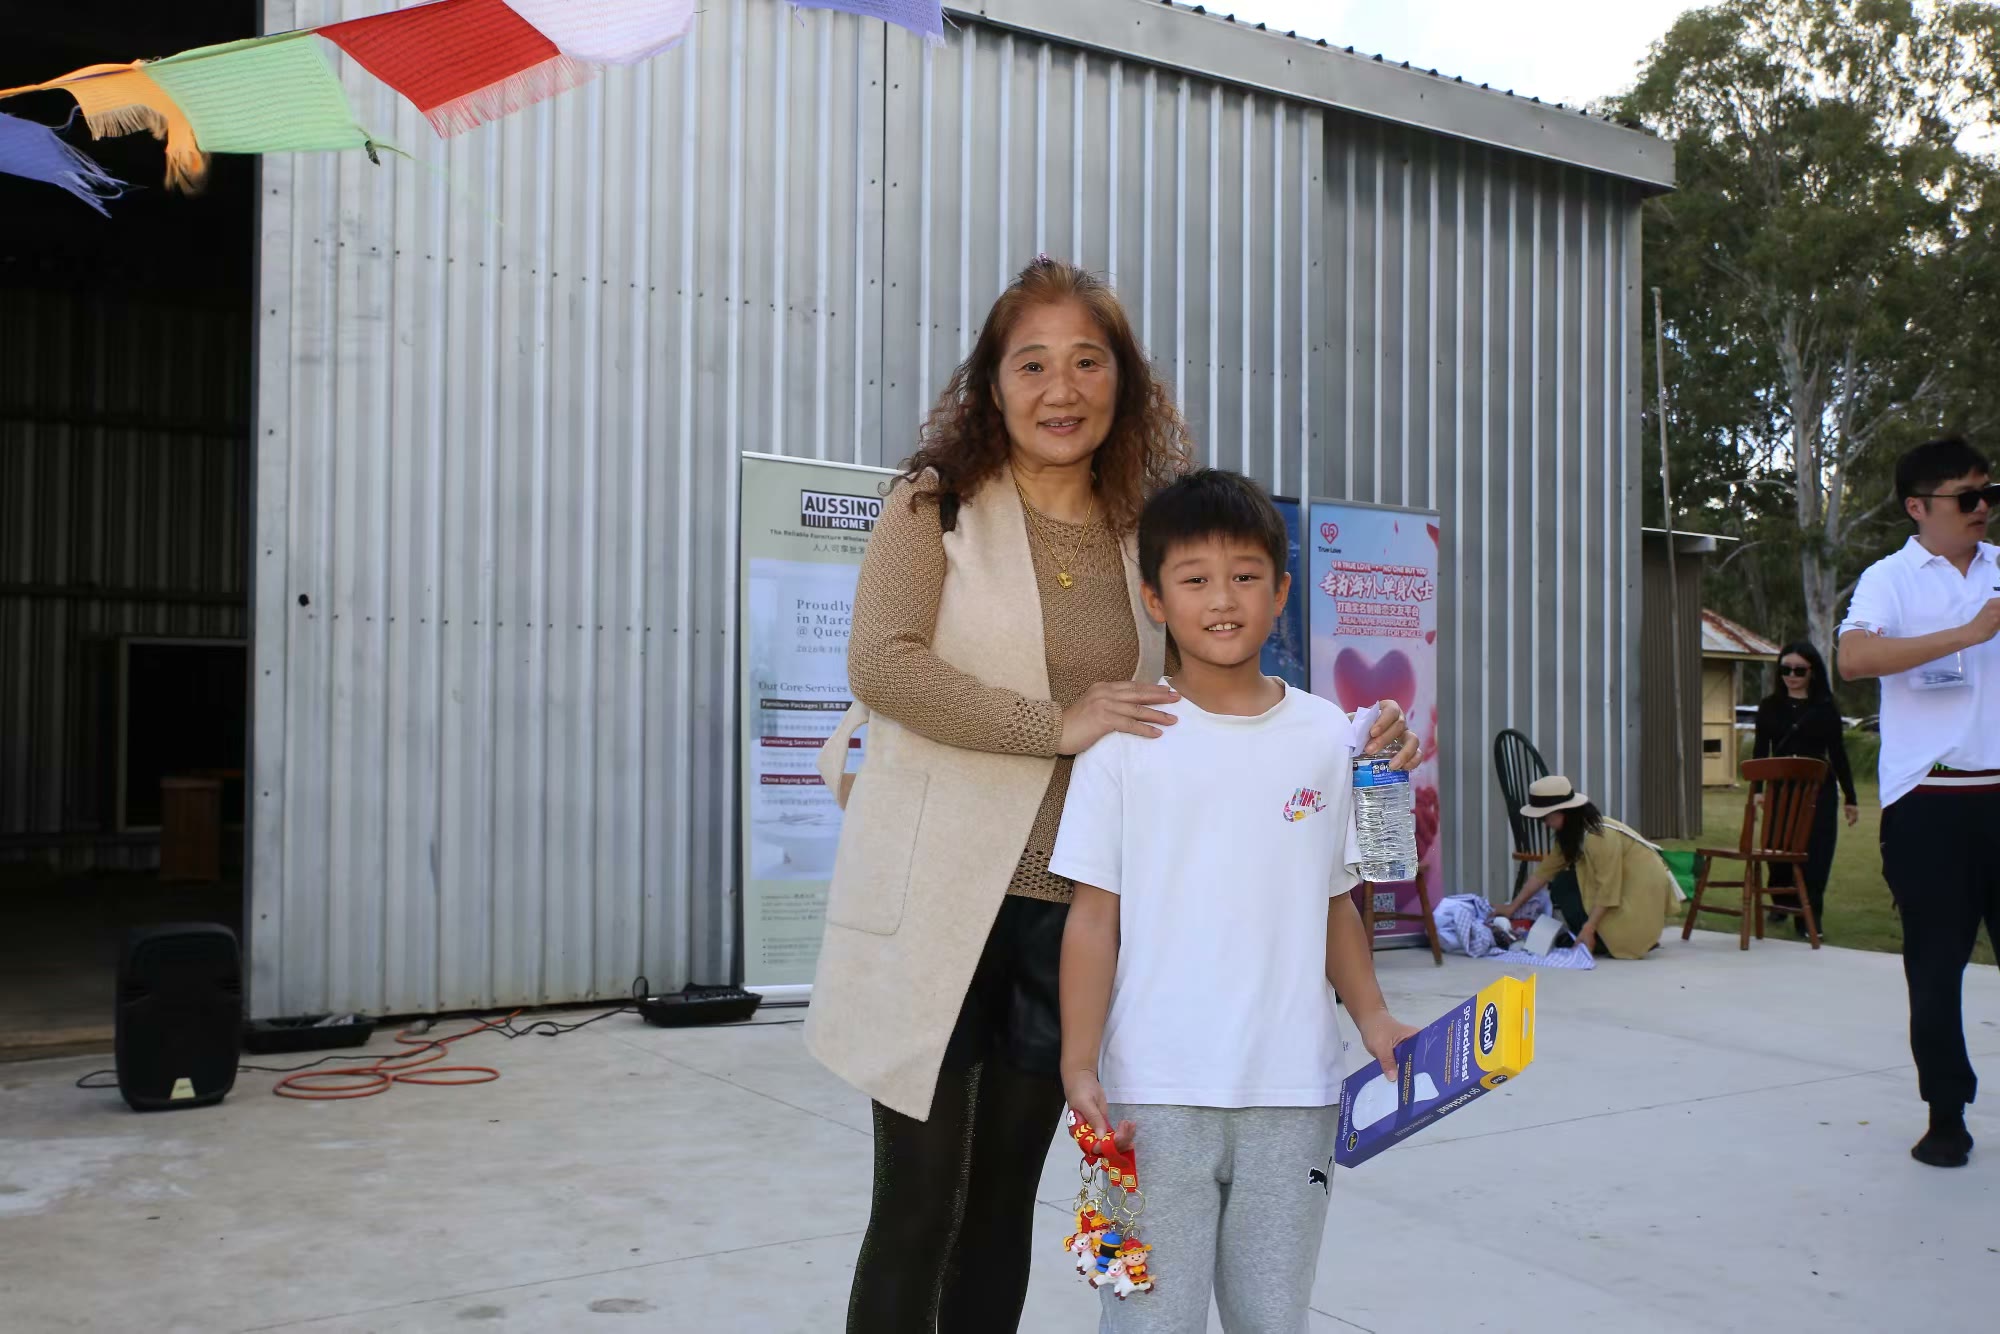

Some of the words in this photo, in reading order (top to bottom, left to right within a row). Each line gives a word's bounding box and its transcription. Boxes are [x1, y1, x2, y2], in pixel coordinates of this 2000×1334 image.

[804, 496, 880, 518] AUSSINO
[832, 518, 866, 530] HOME
[784, 530, 809, 538] Reliable
[1357, 563, 1371, 571] LOVE
[1405, 566, 1416, 574] BUT
[797, 599, 852, 615] Proudly
[797, 612, 809, 624] in
[815, 614, 852, 626] Marc
[813, 627, 850, 639] Quee
[758, 682, 777, 690] Our
[780, 682, 802, 692] Core
[805, 683, 848, 693] Services
[762, 738, 793, 746] Furnishing
[780, 777, 801, 785] Buying
[1464, 1005, 1471, 1021] go
[1484, 1006, 1494, 1051] Scholl
[1462, 1022, 1470, 1082] sockless!
